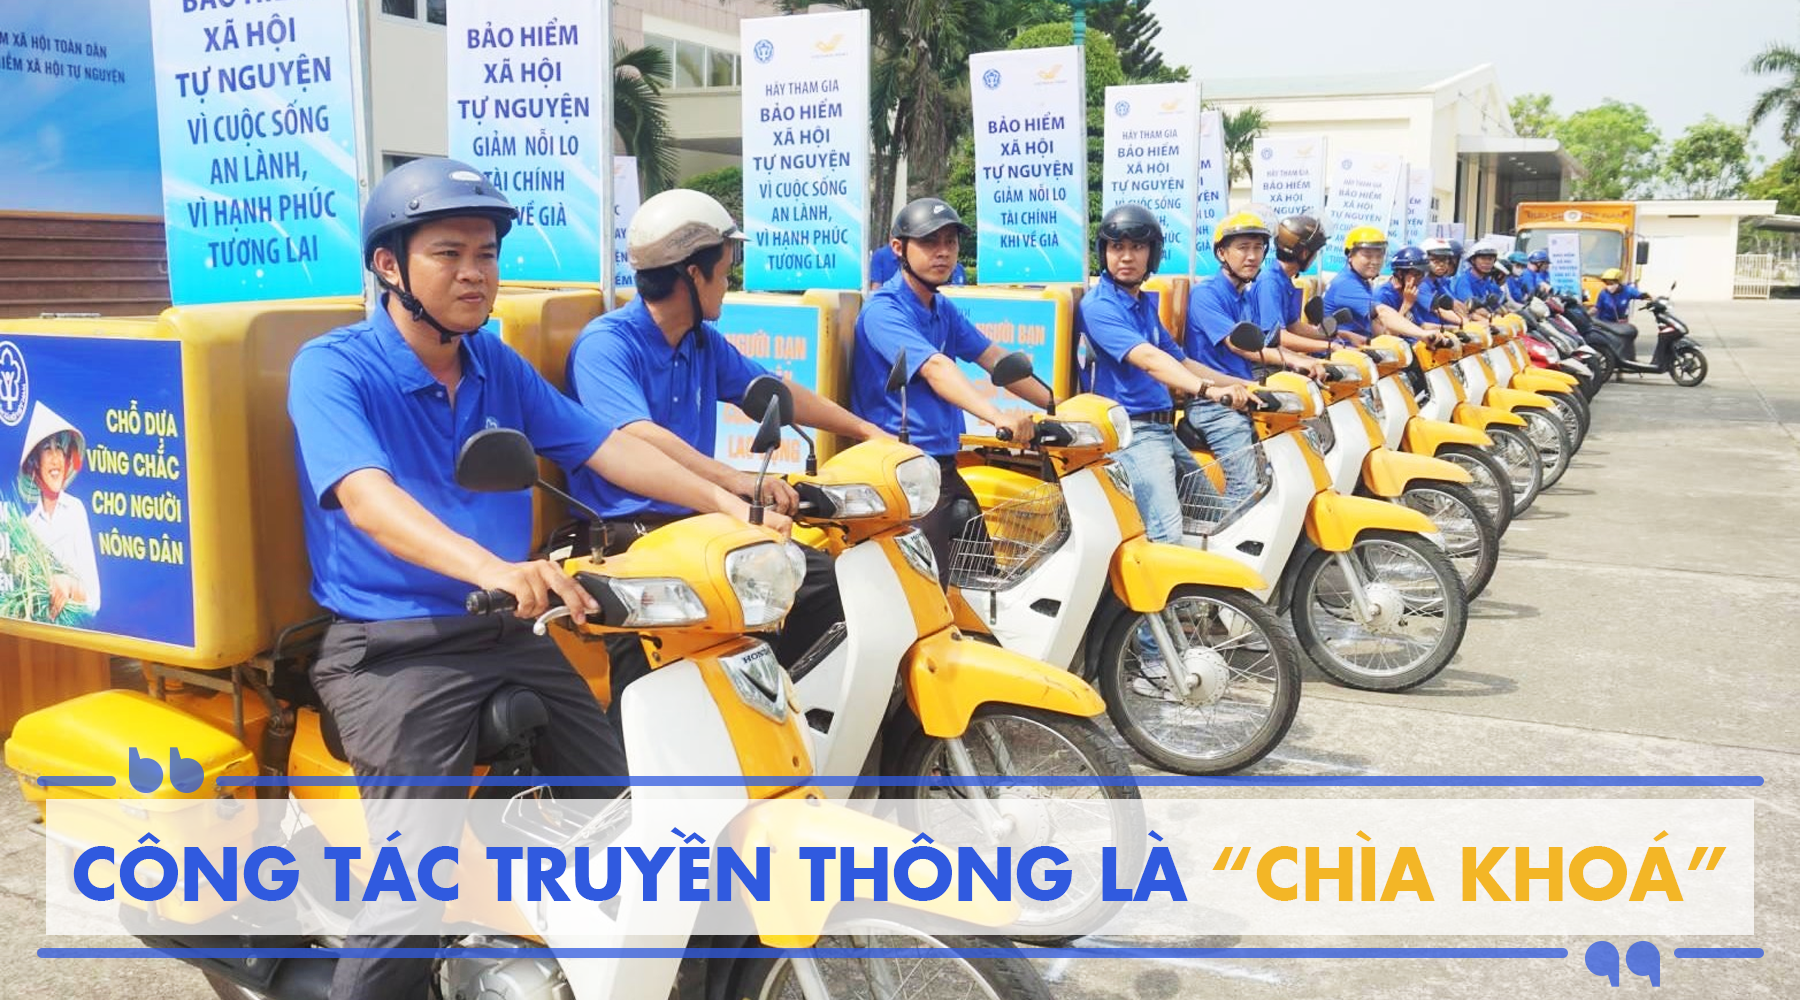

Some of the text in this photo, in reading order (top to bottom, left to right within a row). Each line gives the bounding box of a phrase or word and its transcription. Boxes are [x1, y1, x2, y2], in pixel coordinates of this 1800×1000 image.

[203, 13, 295, 52] XÃ HỘI
[467, 18, 578, 49] BẢO HIỂM
[84, 67, 126, 86] NGUYỆN
[175, 54, 332, 103] TỰ NGUYỆN
[484, 58, 561, 88] XÃ HỘI
[766, 79, 840, 96] HÃY THAM GIA
[458, 93, 590, 125] TỰ NGUYỆN
[760, 98, 842, 122] BẢO HIỂM
[188, 99, 330, 147] VÌ CUỘC SỐNG
[988, 111, 1064, 134] BẢO HIỂM
[1140, 130, 1162, 139] THAM
[1164, 129, 1178, 138] GIA
[474, 128, 578, 157] GIẢM NỖI LO
[774, 126, 829, 148] XÃ HỘI
[1001, 138, 1054, 158] XÃ HỘI
[753, 149, 850, 174] TỰ NGUYỆN
[1118, 142, 1179, 158] BẢO HIỂM
[210, 149, 308, 185] AN LÀNH,
[513, 166, 564, 191] CHÍNH
[983, 160, 1073, 184] TỰ NGUYỆN
[1147, 160, 1169, 176] HỘI
[760, 176, 847, 201] VÌ CUỘC SỐNG
[994, 184, 1066, 203] GIẢM NỖI LO
[1112, 180, 1129, 194] TỰ
[1132, 176, 1184, 193] NGUYỆN
[188, 186, 336, 232] VÌ HẠNH PHÚC
[539, 201, 566, 226] GIÀ
[772, 202, 832, 222] AN LÀNH,
[1001, 208, 1056, 225] TÀI CHÍNH
[756, 226, 848, 250] VÌ HẠNH PHÚC
[1001, 234, 1020, 248] KHI
[1040, 231, 1058, 247] GIÀ
[208, 234, 318, 268] TƯƠNG LAI
[768, 252, 836, 270] TƯƠNG LAI
[1018, 324, 1046, 348] BẠN
[774, 334, 807, 365] BẠN
[106, 400, 178, 443] CHỖ DỰA
[86, 443, 180, 480] VỮNG CHẮC
[92, 490, 182, 523] CHO NGƯỜI
[99, 527, 184, 565] NÔNG DÂN
